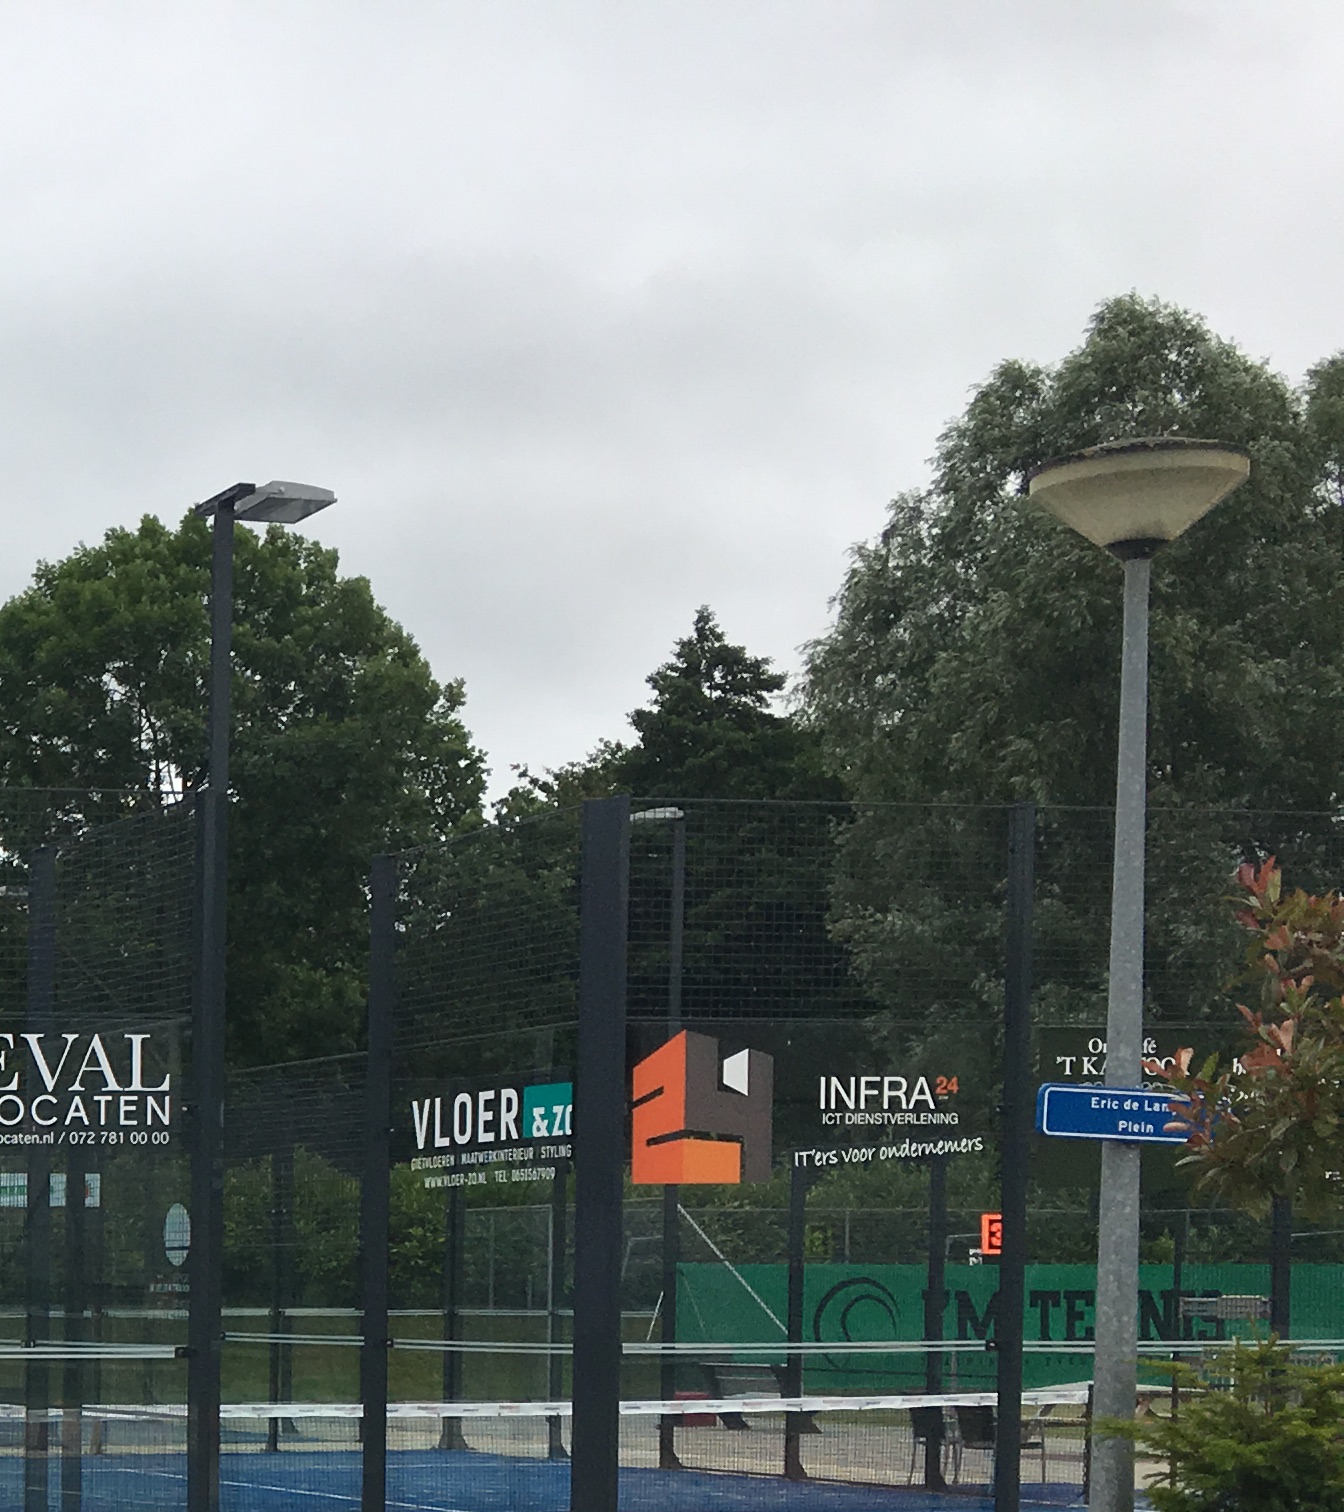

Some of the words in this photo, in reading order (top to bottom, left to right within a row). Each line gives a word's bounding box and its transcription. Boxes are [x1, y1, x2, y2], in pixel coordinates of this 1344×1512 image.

[819, 1076, 936, 1110] INFRA
[935, 1075, 960, 1095] 24
[1091, 1097, 1119, 1110] Eric
[1123, 1099, 1139, 1111] de
[412, 1088, 519, 1150] VLOER
[822, 1113, 843, 1125] ICT
[845, 1113, 959, 1125] DIENSTVERLENING
[1118, 1120, 1154, 1134] Plein
[69, 1132, 95, 1144] 072
[100, 1132, 124, 1144] 781
[130, 1132, 147, 1144] 00
[151, 1132, 170, 1144] 00
[540, 1144, 572, 1159] STYLING
[879, 1137, 984, 1161] ondernemers
